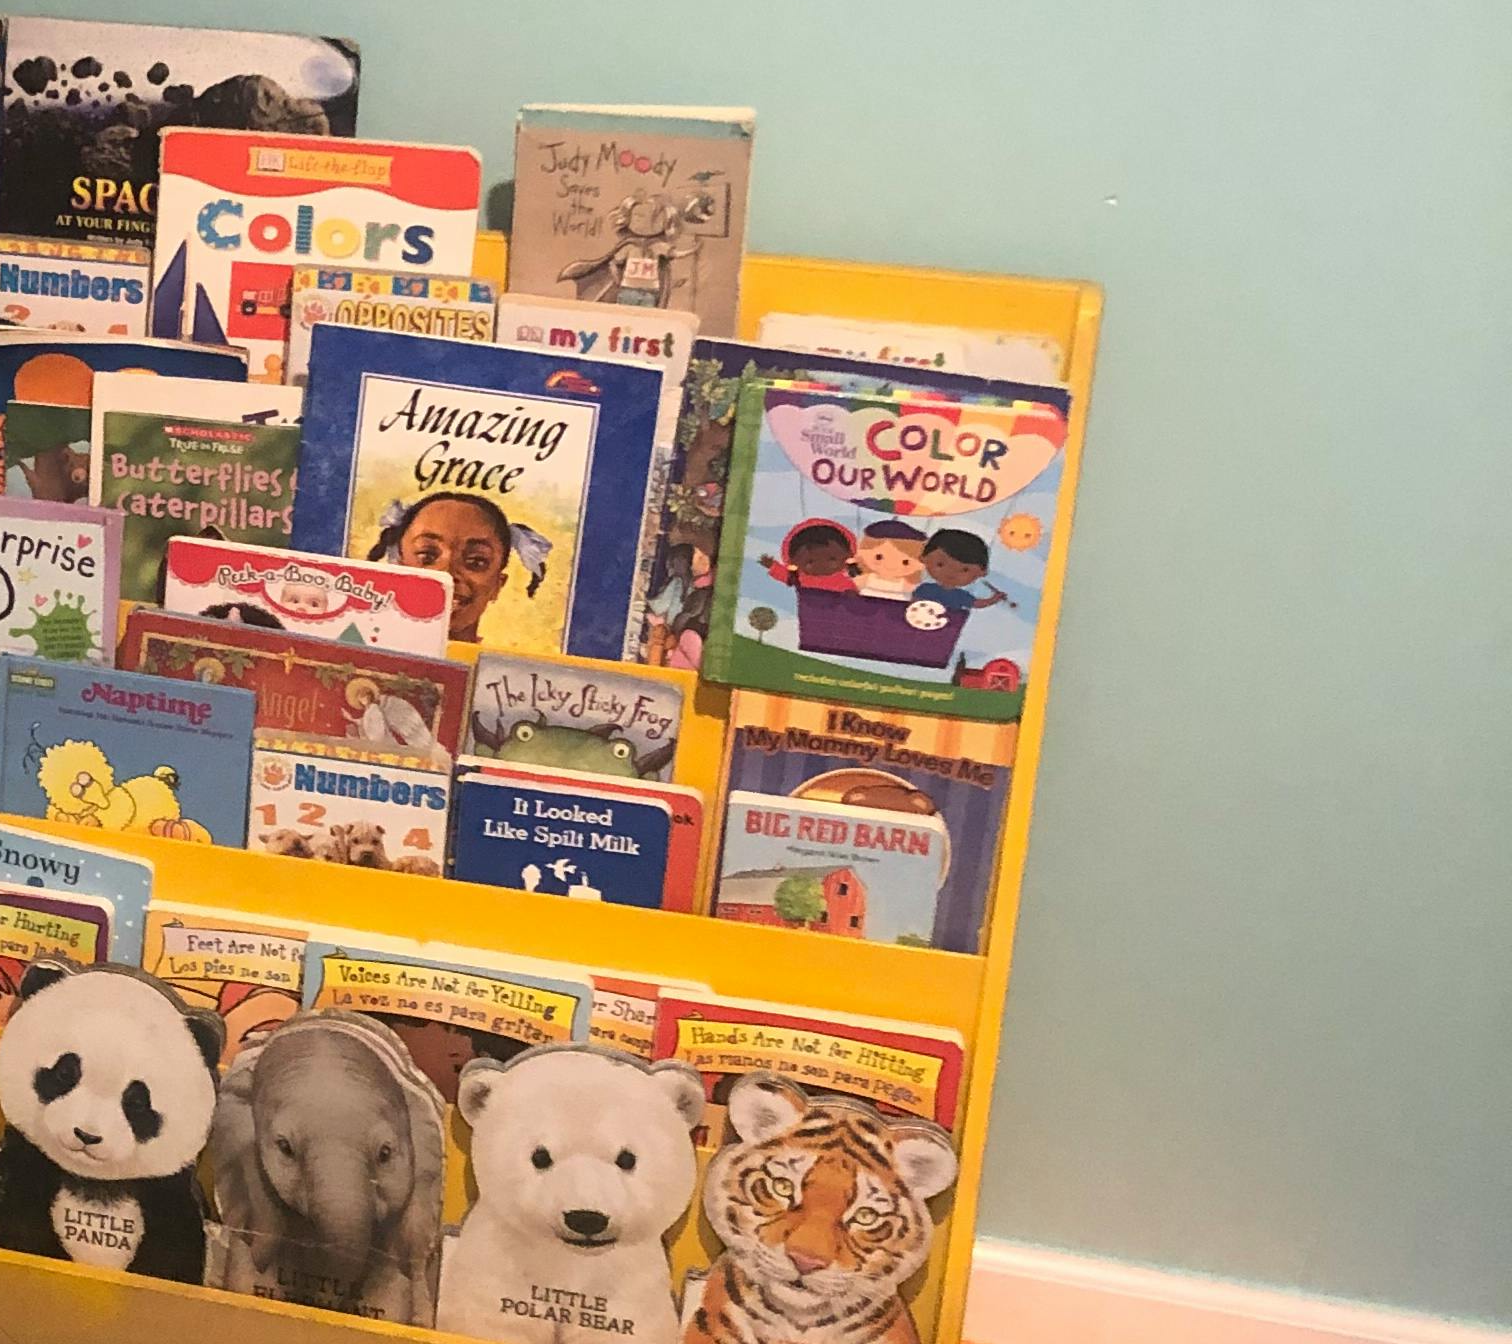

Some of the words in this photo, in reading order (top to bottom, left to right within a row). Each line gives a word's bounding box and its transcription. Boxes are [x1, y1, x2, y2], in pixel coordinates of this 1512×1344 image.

[538, 141, 591, 177] Judy
[595, 141, 678, 188] Moody
[56, 214, 72, 226] AT
[76, 215, 113, 230] YOUR
[197, 198, 434, 264] Colors
[0, 262, 143, 304] Numbers
[549, 328, 599, 354] my
[608, 326, 674, 358] first
[379, 388, 569, 461] Amazing
[801, 430, 845, 445] Small
[810, 442, 857, 459] World
[866, 420, 1008, 471] COLOR
[111, 453, 282, 497] Butterflies
[413, 441, 526, 495] Grace
[812, 458, 876, 491] OUR
[882, 464, 996, 503] WORLD
[115, 492, 294, 534] Caterpillars
[335, 574, 393, 609] Baby!
[81, 681, 213, 725] Naptime
[486, 675, 526, 718] The
[530, 674, 572, 711] Icky
[568, 684, 626, 723] Sticky
[623, 695, 673, 739] Frog
[827, 710, 837, 731] I
[841, 712, 911, 742] Know
[745, 726, 780, 751] My
[885, 744, 952, 775] Loves
[958, 759, 996, 786] Me
[294, 763, 446, 810] Numbers
[255, 804, 277, 826] 1
[297, 802, 326, 827] 2
[513, 797, 529, 815] It
[534, 800, 613, 827] Looked
[403, 828, 432, 850] 4
[483, 819, 528, 841] Like
[533, 826, 585, 848] Spilt
[589, 832, 640, 855] Milk
[745, 809, 790, 837] BIG
[797, 816, 848, 844] RED
[854, 823, 931, 856] BARN
[0, 939, 28, 955] para
[13, 911, 81, 947] Hurting
[187, 935, 224, 954] Feet
[228, 940, 255, 955] Are
[260, 943, 287, 960] Not
[169, 957, 198, 974] Los
[204, 958, 235, 978] pies
[241, 967, 260, 978] no
[265, 970, 291, 982] son
[339, 964, 391, 984] Voices
[396, 970, 427, 989] Are
[432, 976, 460, 994] Not
[465, 980, 488, 998] for
[491, 984, 558, 1022] Yelling
[333, 989, 352, 1005] La
[359, 993, 390, 1007] voz
[397, 998, 419, 1010] no
[424, 1001, 443, 1014] es
[449, 1005, 487, 1023] para
[491, 1015, 554, 1043] gritar
[691, 1026, 747, 1045] Hands
[752, 1031, 784, 1049] Are
[792, 1036, 821, 1055] Not
[829, 1042, 853, 1060] for
[856, 1047, 926, 1084] Hitting
[718, 1055, 773, 1070] manos
[778, 1060, 798, 1073] no
[801, 1063, 830, 1078] son
[832, 1070, 870, 1090] para
[63, 1207, 136, 1234] LITTLE
[64, 1225, 132, 1252] PANDA
[500, 1297, 572, 1325] POLAR
[581, 1308, 635, 1336] BEAR
[531, 1284, 608, 1312] LITTLE
